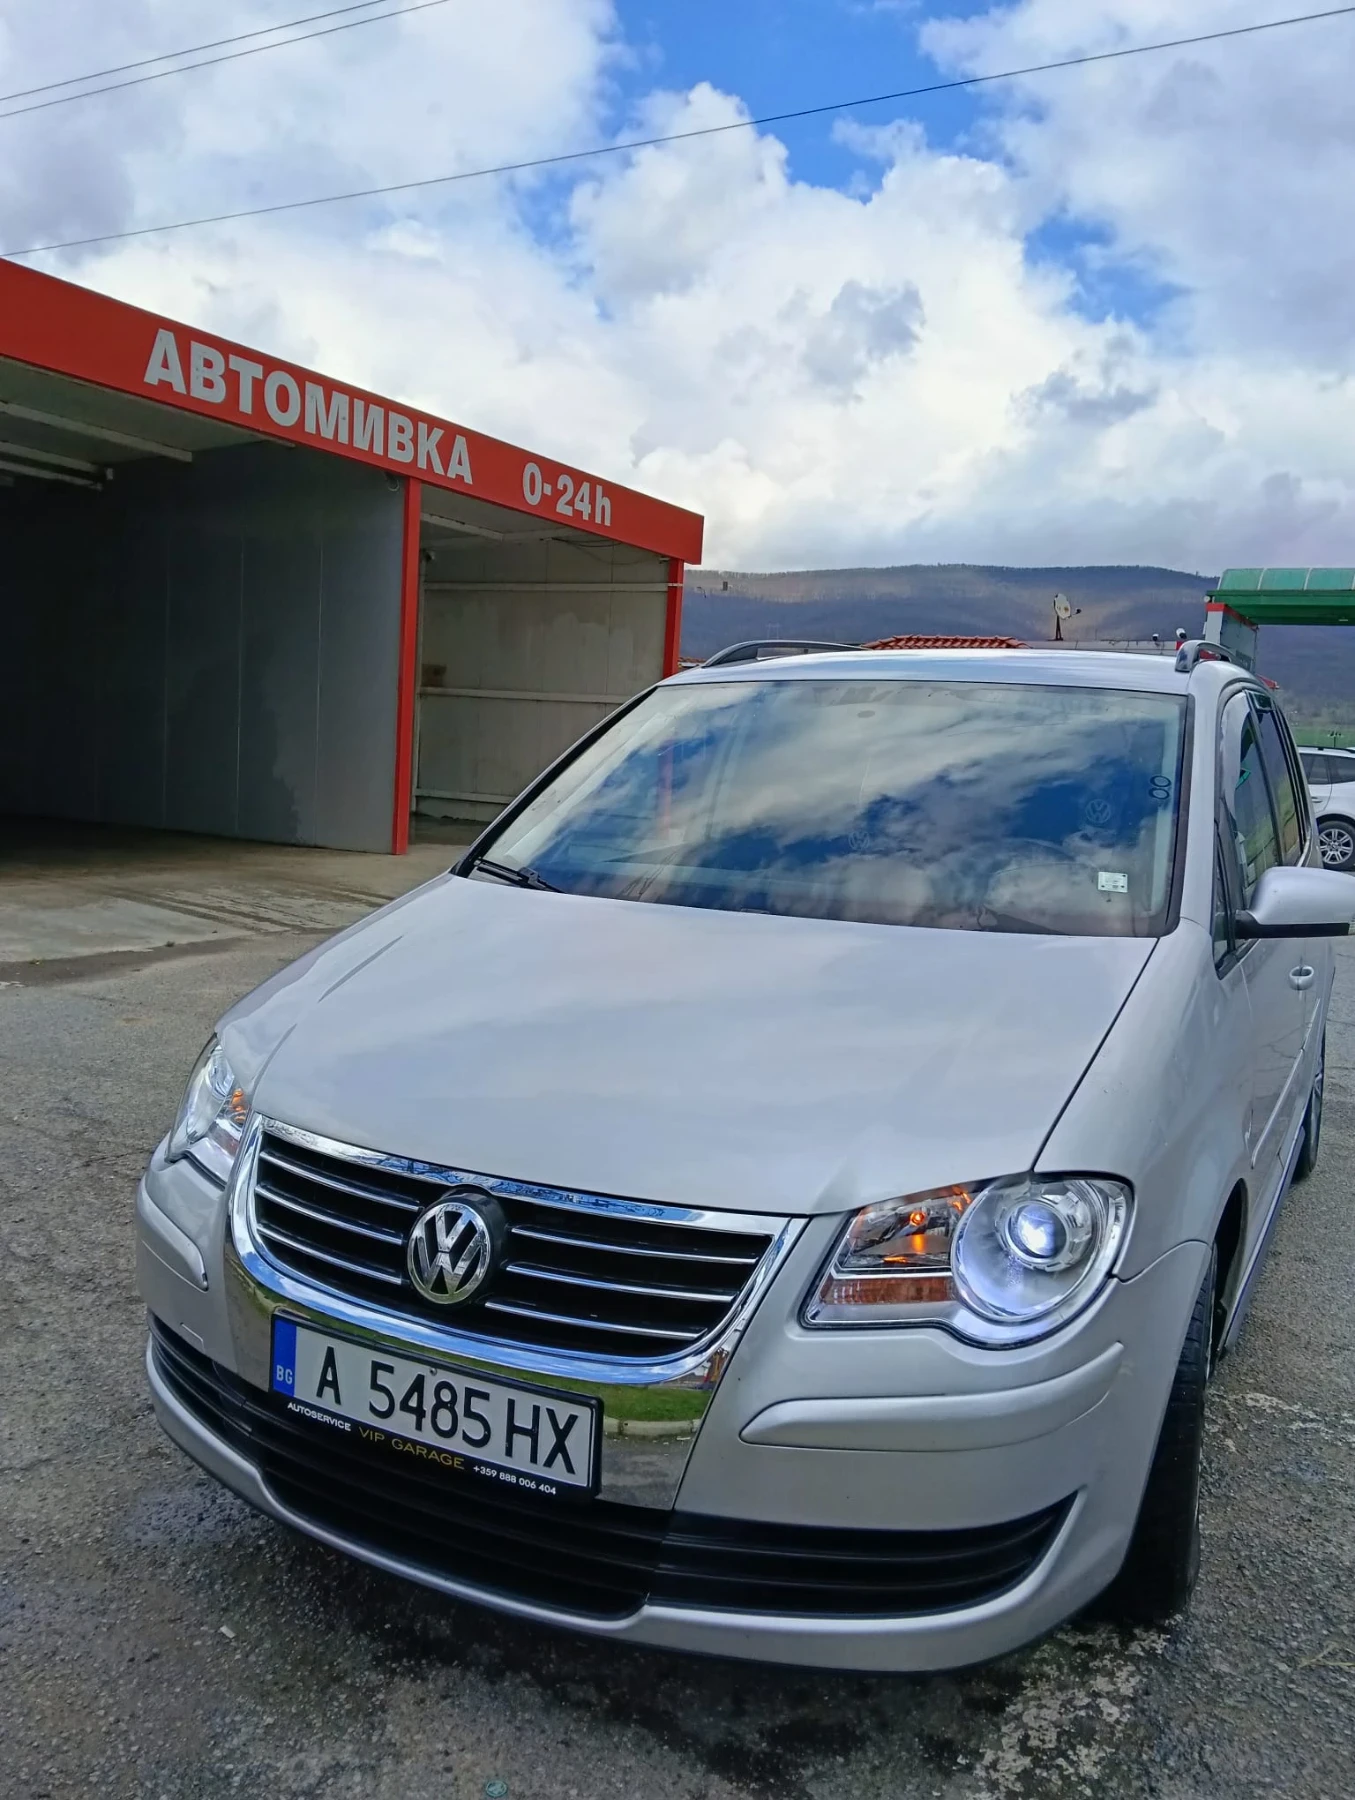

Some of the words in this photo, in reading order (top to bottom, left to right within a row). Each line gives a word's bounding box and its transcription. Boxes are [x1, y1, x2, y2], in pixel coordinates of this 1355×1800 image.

[143, 328, 473, 485] АВТОМИВКА
[522, 462, 612, 527] 0-24h
[407, 1202, 490, 1304] VW
[276, 1365, 293, 1386] BG
[316, 1346, 342, 1406] A
[369, 1360, 491, 1449] 5485
[505, 1398, 579, 1475] HX
[287, 1402, 352, 1432] AUTOSERVICE
[358, 1426, 385, 1442] VIP
[391, 1438, 465, 1470] GARAGE
[473, 1465, 497, 1478] +359
[499, 1472, 517, 1484] 888
[518, 1477, 536, 1489] 006
[538, 1483, 557, 1495] 404
